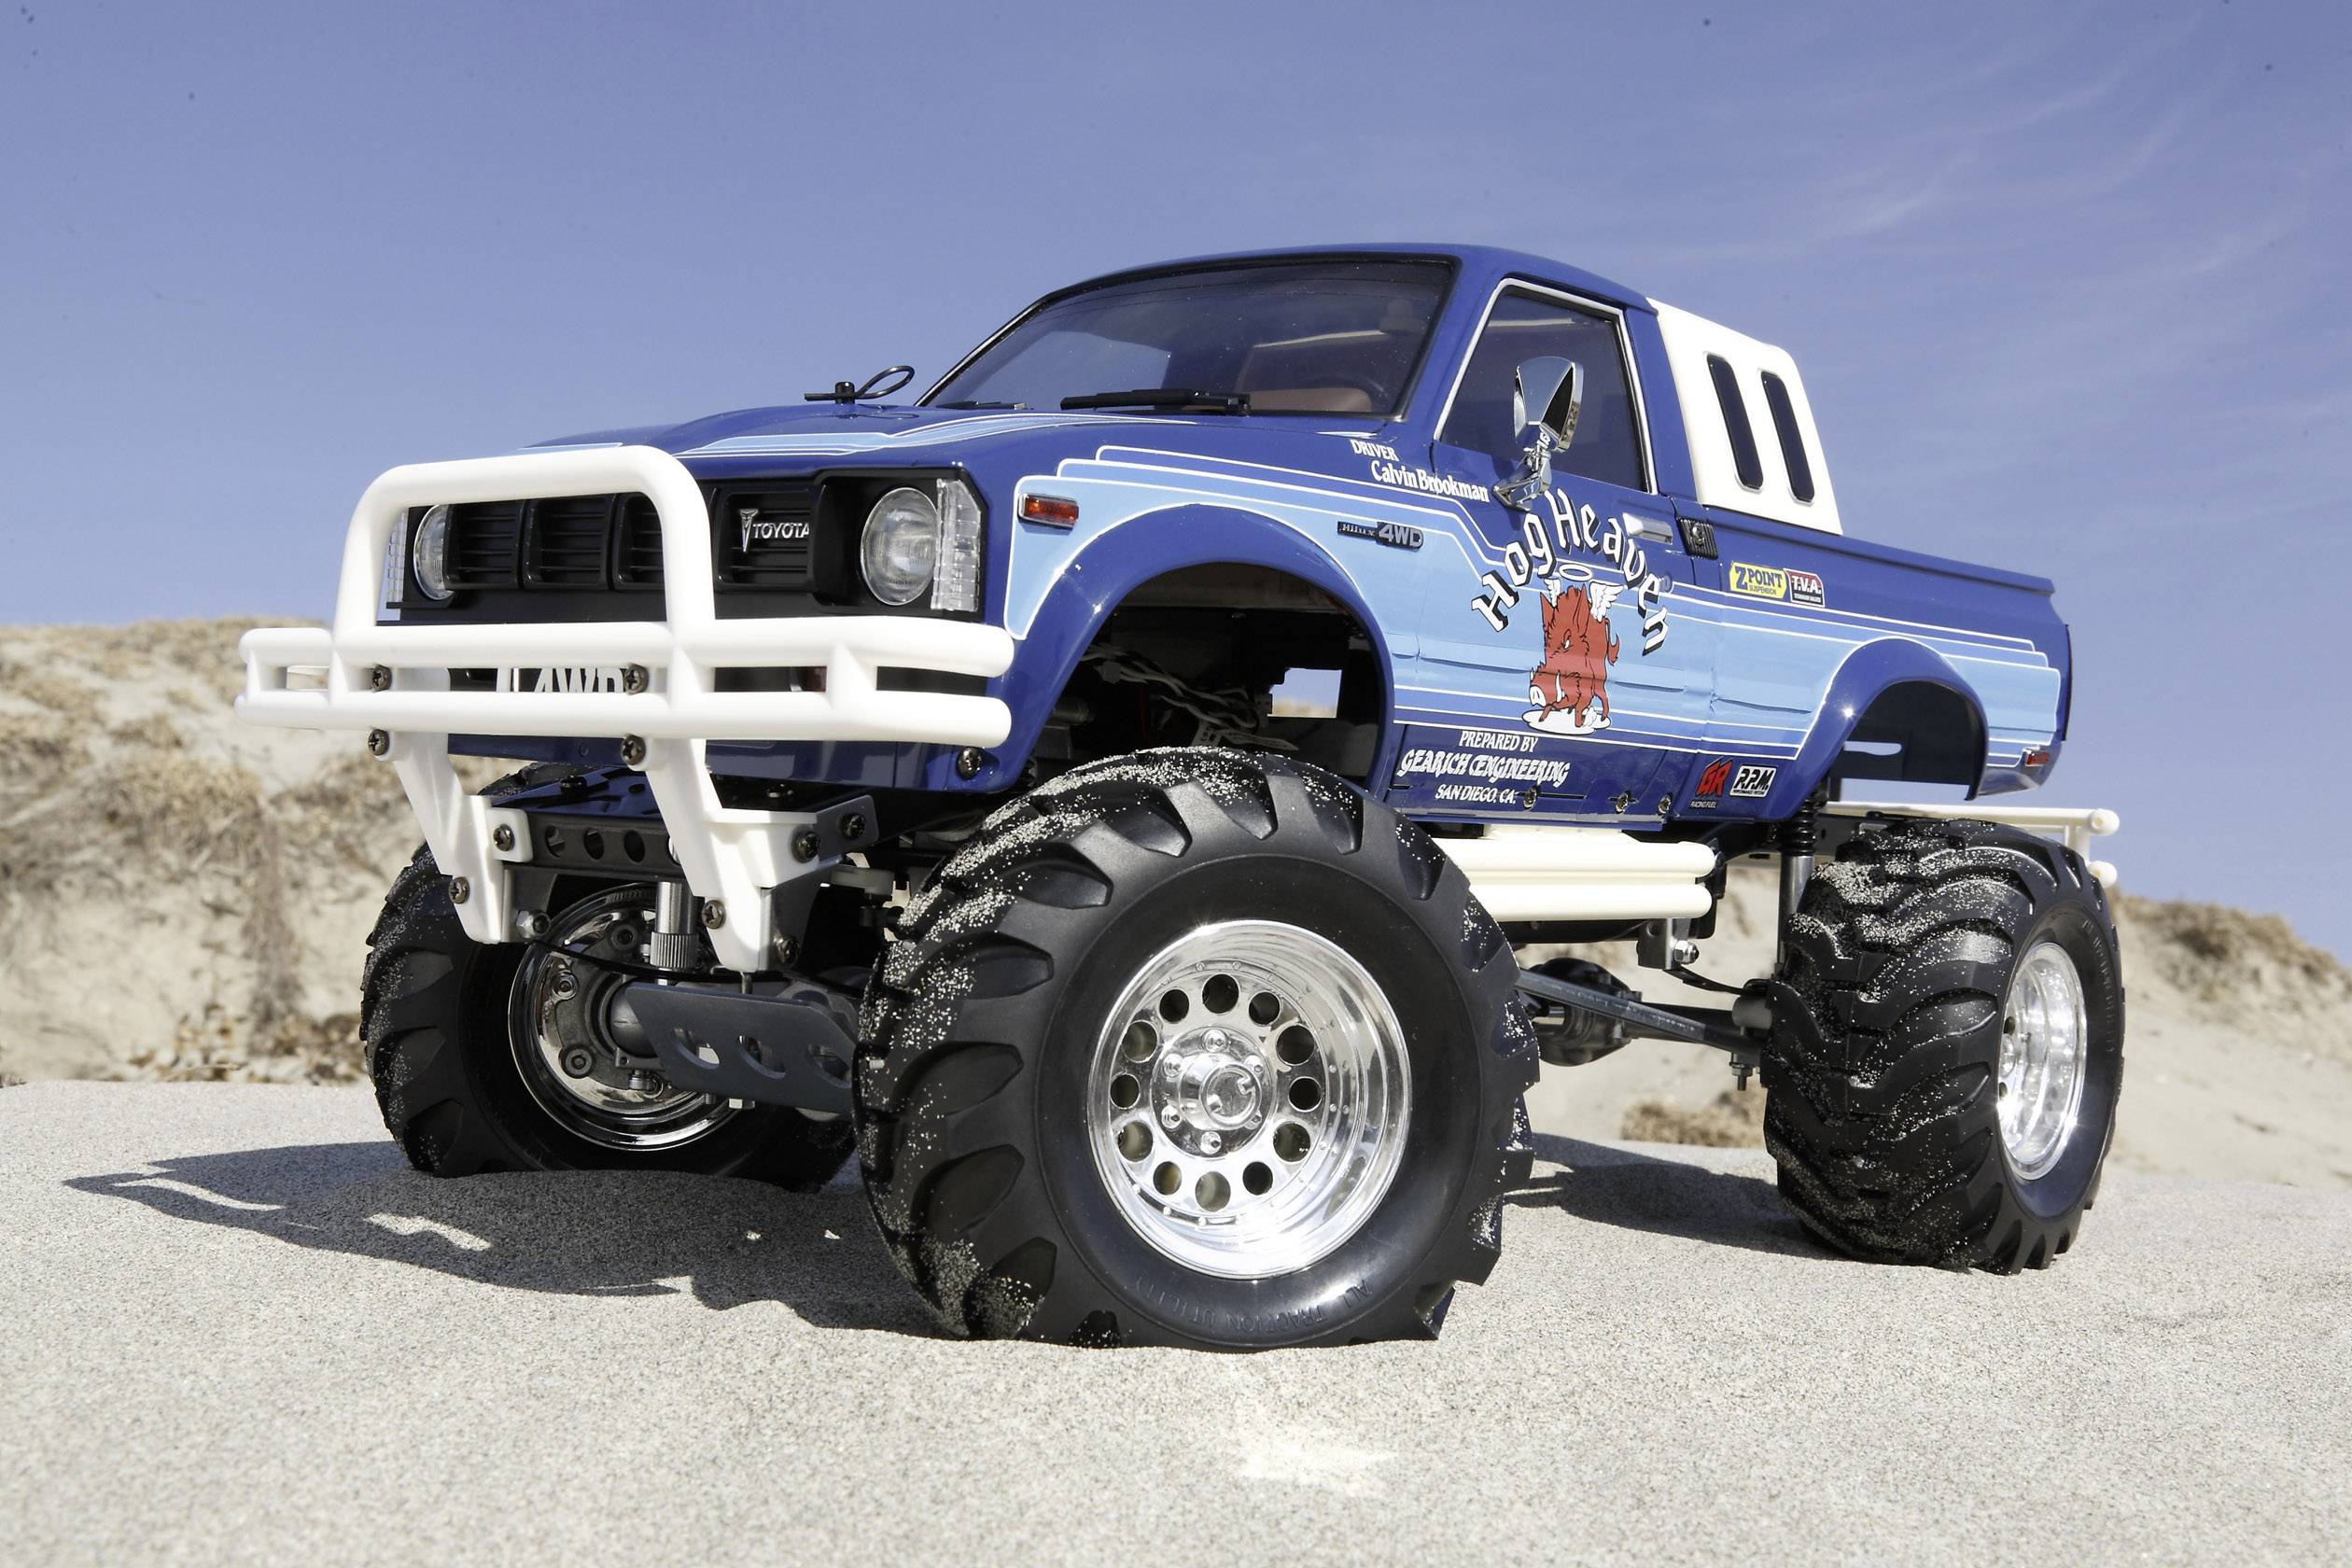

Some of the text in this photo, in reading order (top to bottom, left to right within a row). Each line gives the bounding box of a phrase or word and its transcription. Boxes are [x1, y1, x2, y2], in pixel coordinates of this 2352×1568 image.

[1350, 439, 1399, 461] DRIVER
[1371, 460, 1491, 503] Calvin Brookman
[752, 523, 810, 539] TOYOTA
[1379, 524, 1423, 548] 4WD
[1471, 488, 1669, 656] Hog Heaven
[1734, 566, 1783, 590] Z POINT
[1792, 575, 1822, 595] T.V.A.
[1459, 731, 1538, 752] PREPARED BY
[1469, 754, 1570, 788] ENGINEERING
[1435, 784, 1462, 800] SAN
